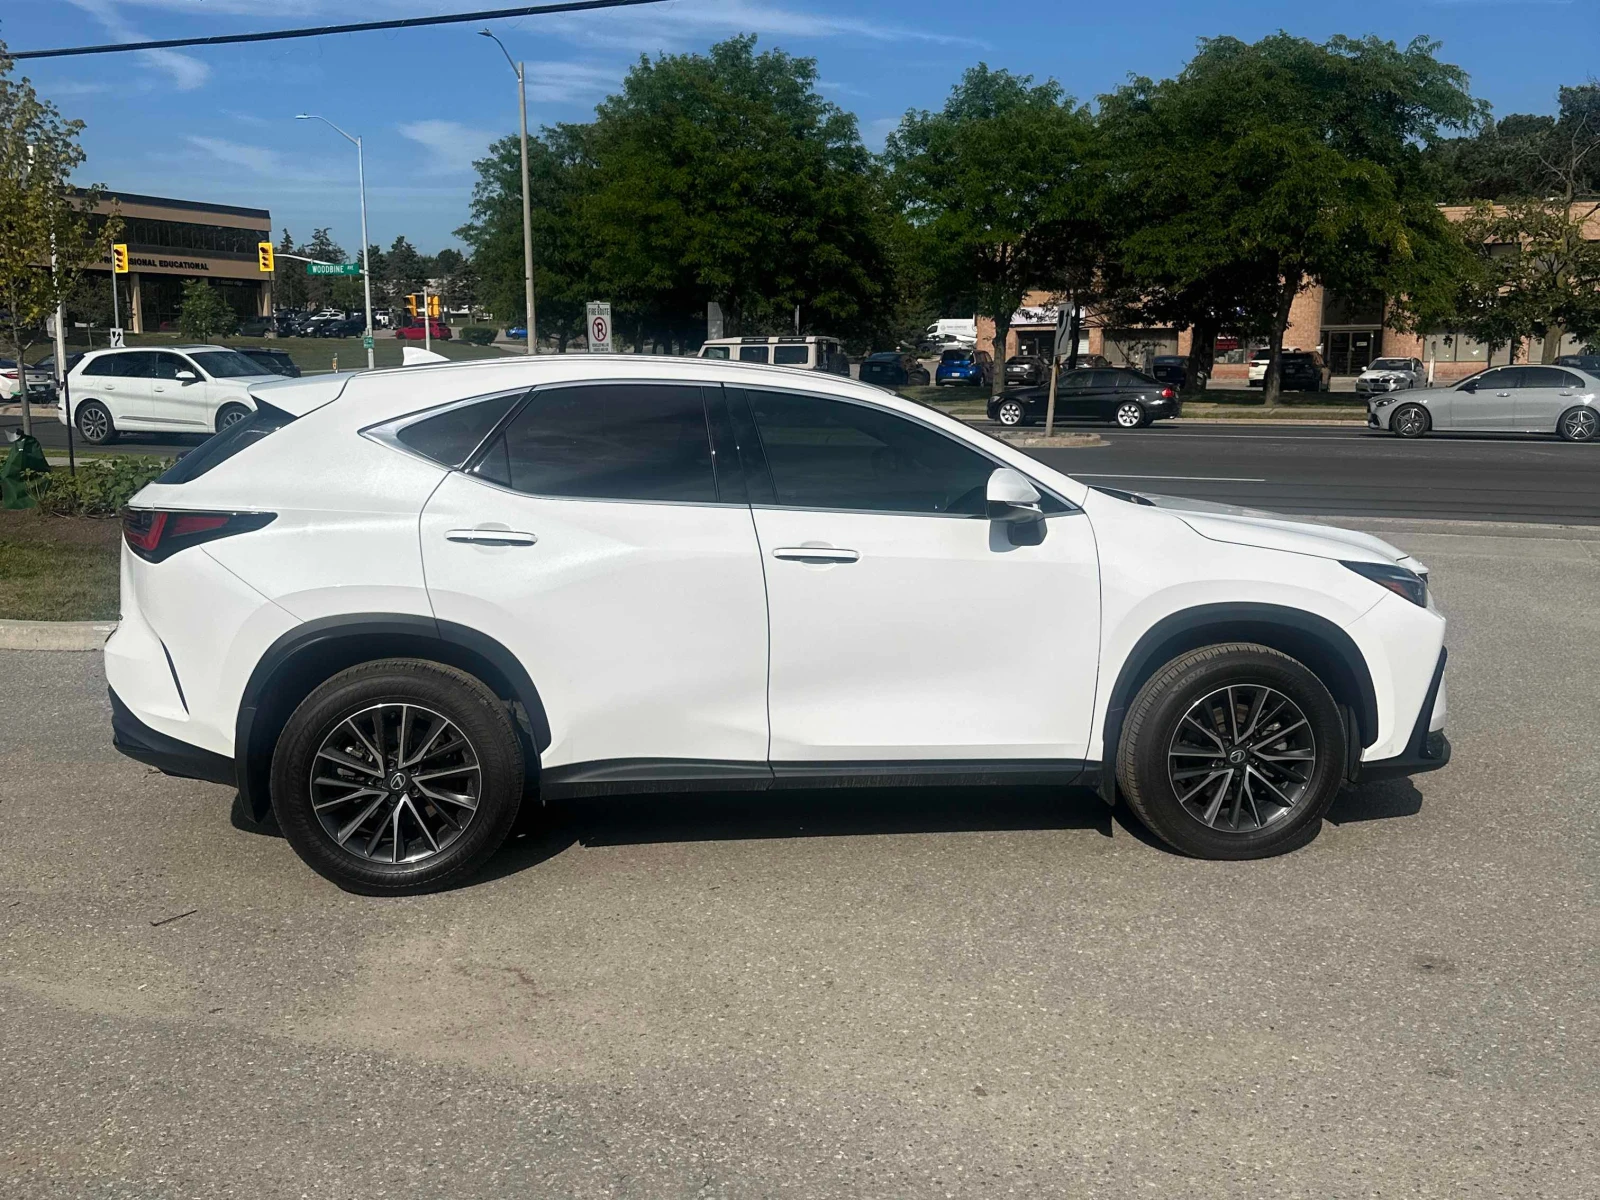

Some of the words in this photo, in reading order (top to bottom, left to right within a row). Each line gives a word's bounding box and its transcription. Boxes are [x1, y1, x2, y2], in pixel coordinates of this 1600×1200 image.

[99, 255, 157, 267] RSIONAL
[159, 260, 209, 271] EDUCATIONAL
[312, 265, 344, 273] WOODBINE
